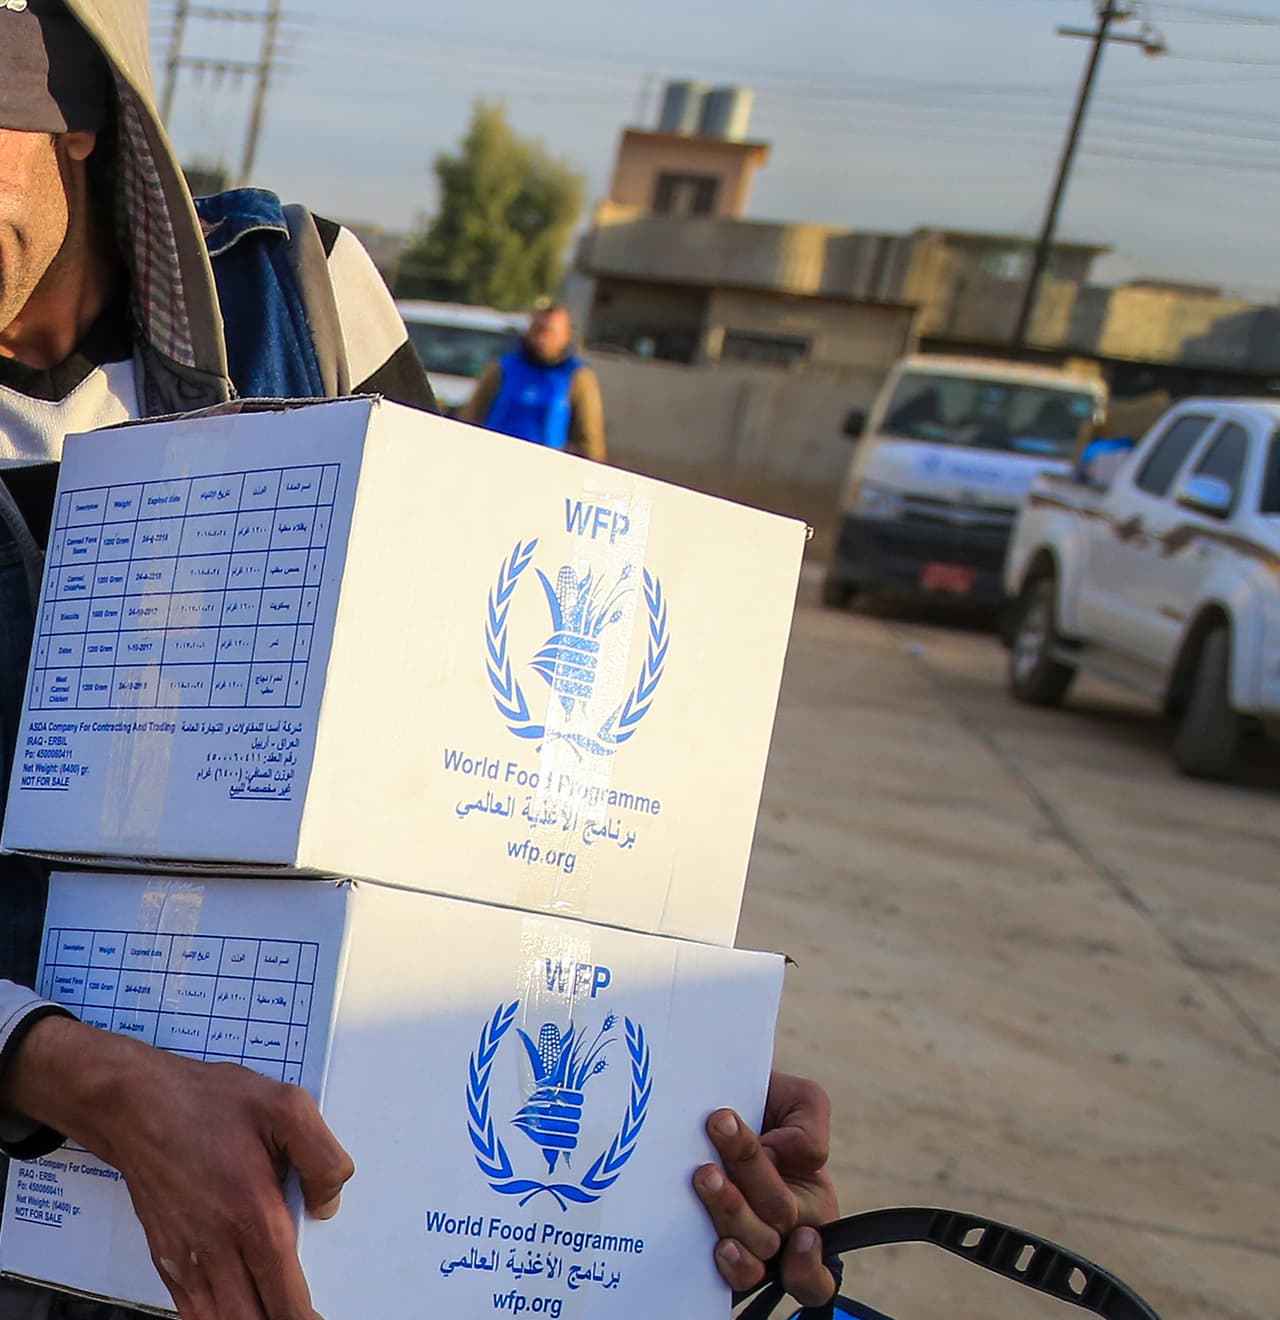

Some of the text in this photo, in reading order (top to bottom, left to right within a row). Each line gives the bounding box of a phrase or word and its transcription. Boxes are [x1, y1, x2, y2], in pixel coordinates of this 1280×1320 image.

[564, 498, 630, 544] WFP
[29, 722, 176, 734] ASDA Company For Contracting And Trading
[283, 720, 302, 733] شركة
[27, 737, 42, 746] IRAQ
[48, 737, 67, 745] ERBIL
[23, 764, 34, 773] Net
[35, 764, 58, 775] Weight:
[21, 777, 70, 786] NOT FOR SALE
[444, 748, 500, 780] World
[558, 774, 660, 815] Programme
[455, 789, 516, 819] العالمي
[507, 840, 576, 874] wfp.org
[546, 958, 611, 998] WFP
[19, 1168, 35, 1179] IRAQ
[39, 1171, 58, 1183] ERBIL
[39, 1158, 67, 1172] Company
[69, 1162, 80, 1172] For
[81, 1165, 119, 1181] Contracting
[16, 1194, 26, 1204] Net
[15, 1207, 62, 1223] NOT FOR SALE
[425, 1211, 644, 1254] World Food Programme
[440, 1247, 621, 1290] برنامج الأغذية العالمي
[493, 1290, 563, 1319] wfp.org
